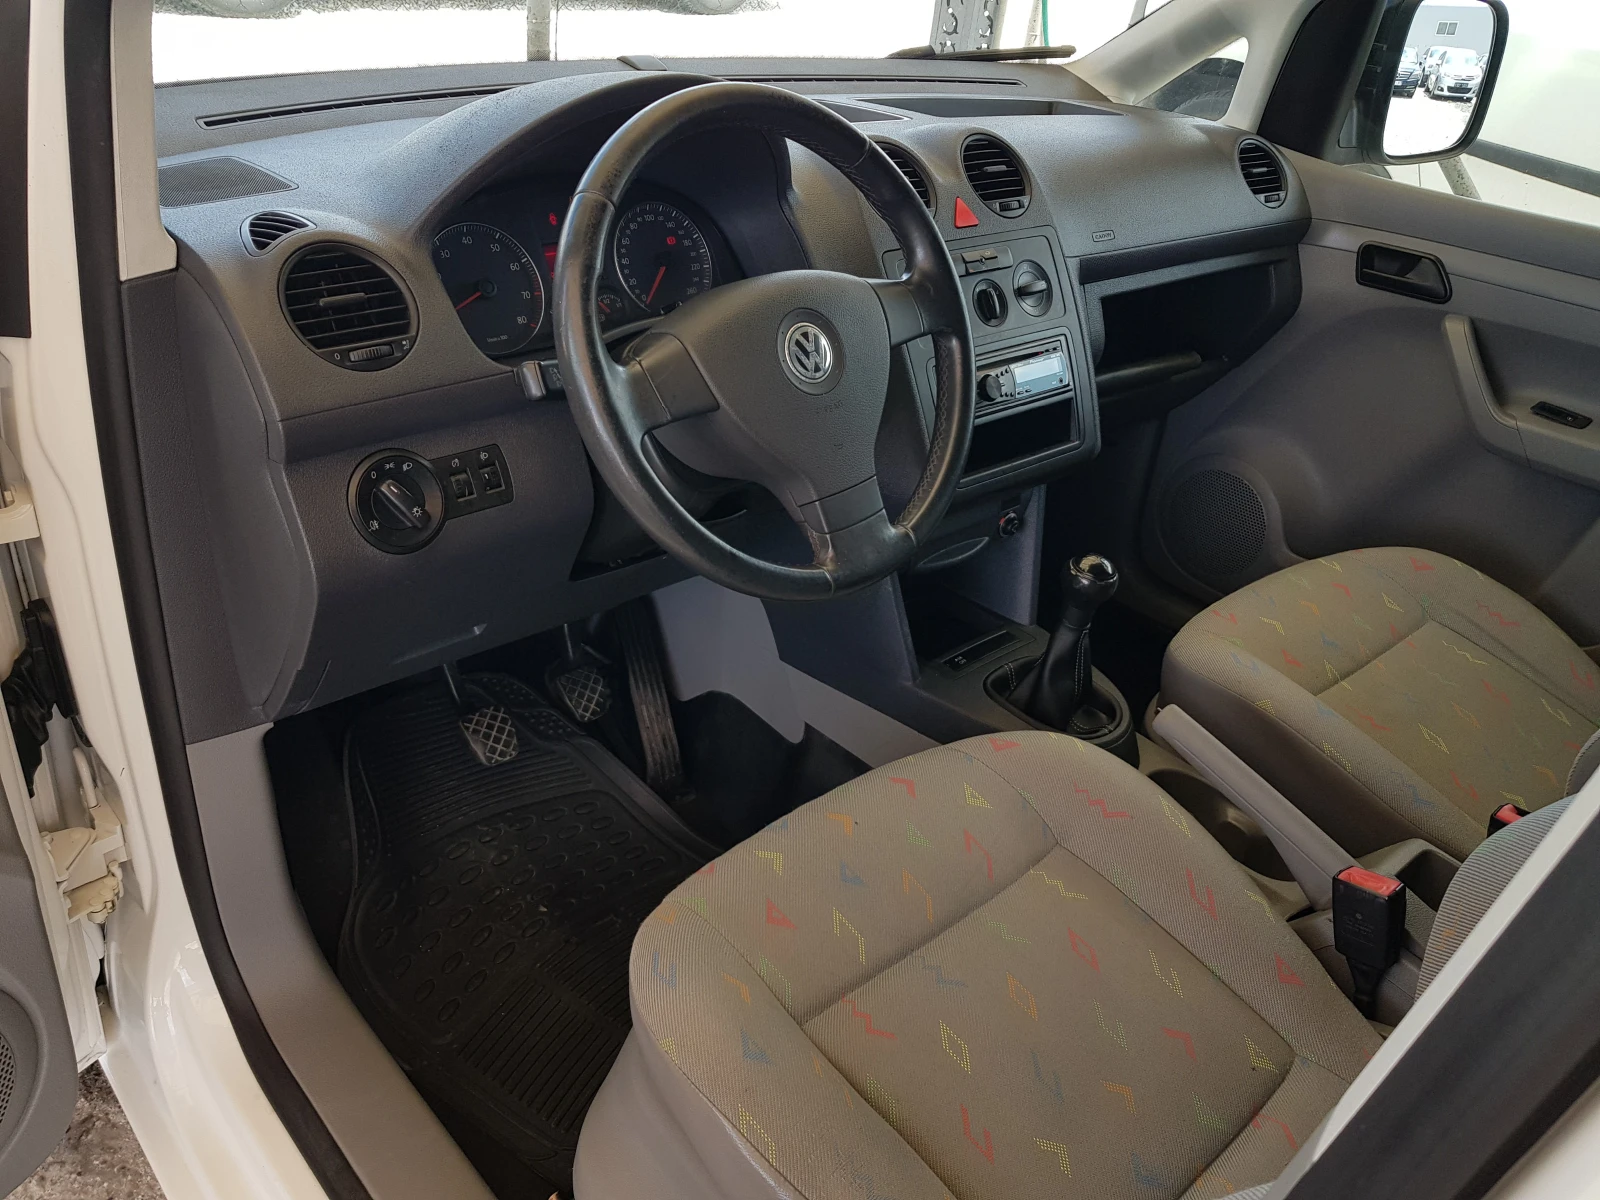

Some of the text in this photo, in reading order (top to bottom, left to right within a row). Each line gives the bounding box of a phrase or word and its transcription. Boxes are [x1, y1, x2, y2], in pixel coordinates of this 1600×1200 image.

[630, 222, 638, 230] 80
[462, 236, 473, 244] 40
[490, 243, 500, 252] 50
[440, 249, 450, 258] 30
[510, 262, 520, 271] 60
[521, 291, 531, 299] 70
[687, 287, 697, 295] 260
[517, 316, 527, 324] 80
[371, 471, 377, 479] 0
